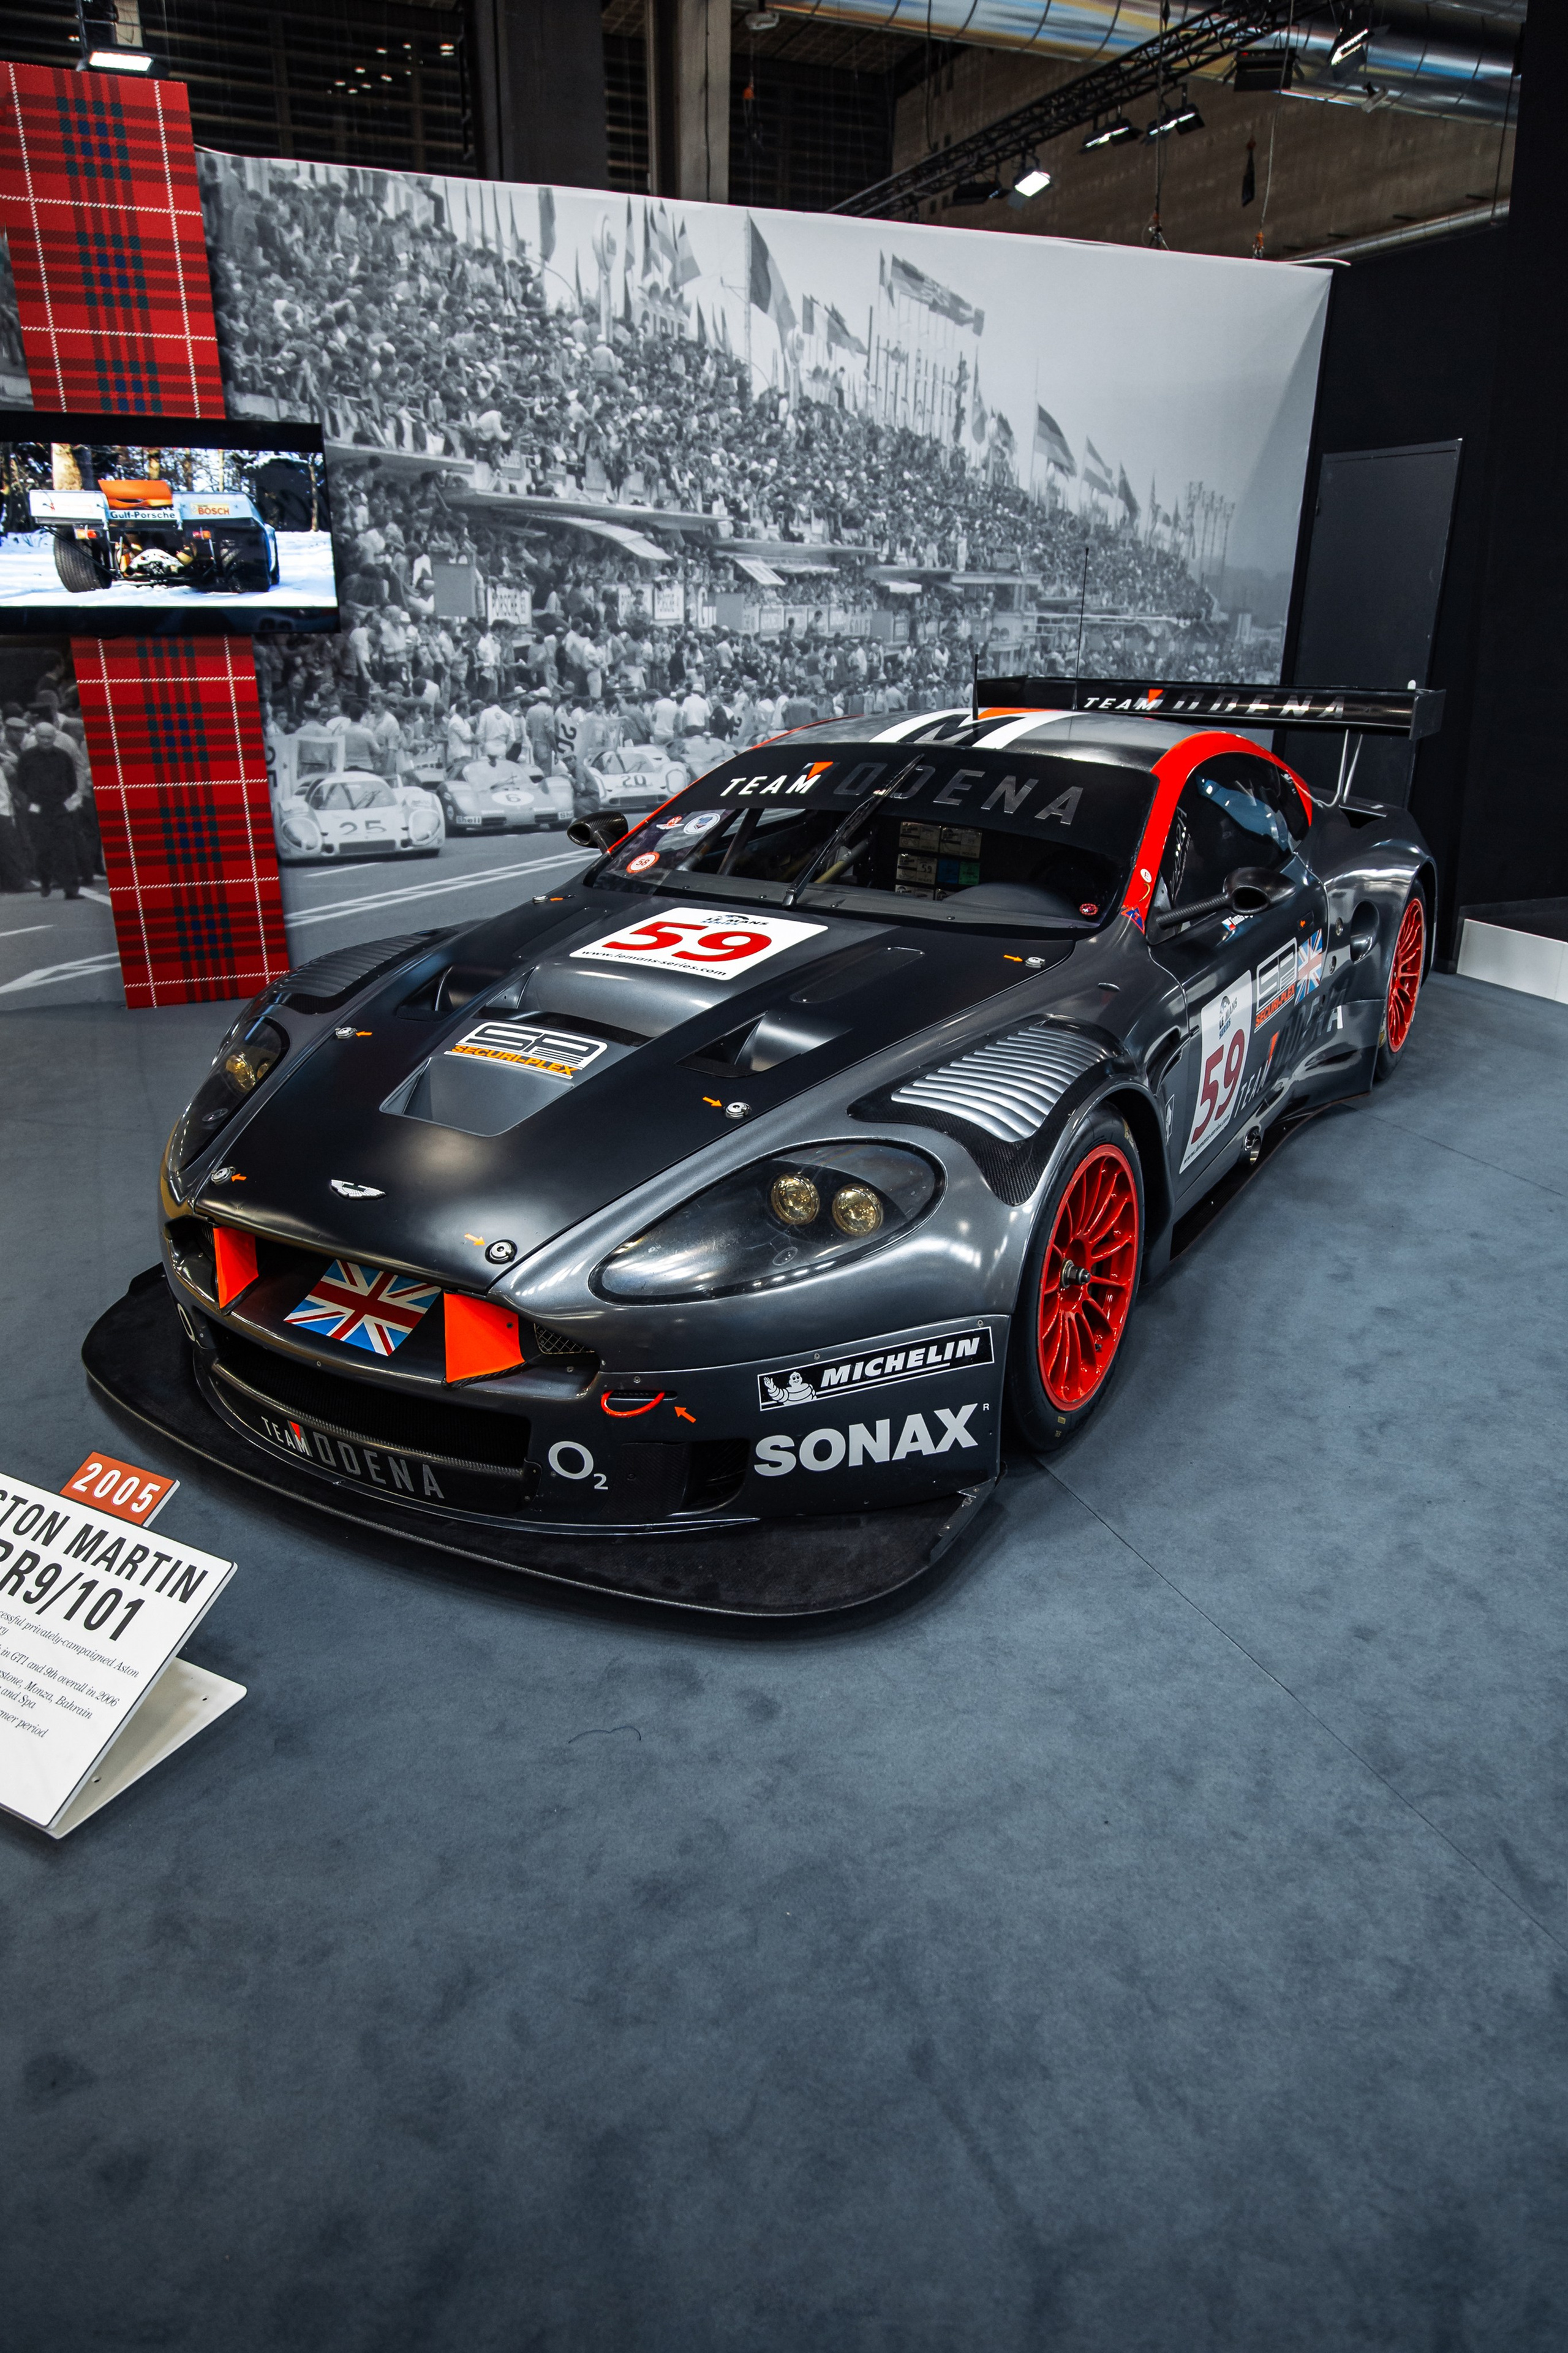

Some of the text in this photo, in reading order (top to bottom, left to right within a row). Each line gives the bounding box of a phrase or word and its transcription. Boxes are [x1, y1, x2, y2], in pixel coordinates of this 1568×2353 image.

[110, 510, 176, 519] Gulf-Porsche
[198, 507, 230, 515] BOSCH
[1083, 697, 1158, 711] TEAM
[621, 775, 647, 787] 20
[720, 774, 823, 797] TEAM
[505, 793, 521, 803] 6
[339, 820, 387, 836] 25
[458, 815, 481, 824] Shell
[921, 864, 932, 873] 59
[601, 921, 772, 962] 59
[581, 949, 727, 978] www.lemans-series.com
[1255, 983, 1296, 1027] SECURI-PLEX
[451, 1044, 578, 1076] SECURI-PLEX
[1191, 1029, 1245, 1145] 59
[821, 1337, 980, 1388] MICHELIN
[260, 1416, 309, 1455] TEAM
[754, 1403, 979, 1477] SONAX
[72, 1462, 162, 1513] 2005
[63, 1523, 209, 1604] MARTIN
[21, 1622, 117, 1667] privately-campaigned
[114, 1661, 140, 1678] Aston
[1, 1647, 121, 1707] in GT1 and 9th overall in 2006
[1, 1686, 37, 1709] and Spa
[24, 1680, 53, 1704] Monza,
[55, 1695, 93, 1720] Bahrain
[15, 1718, 49, 1738] period
